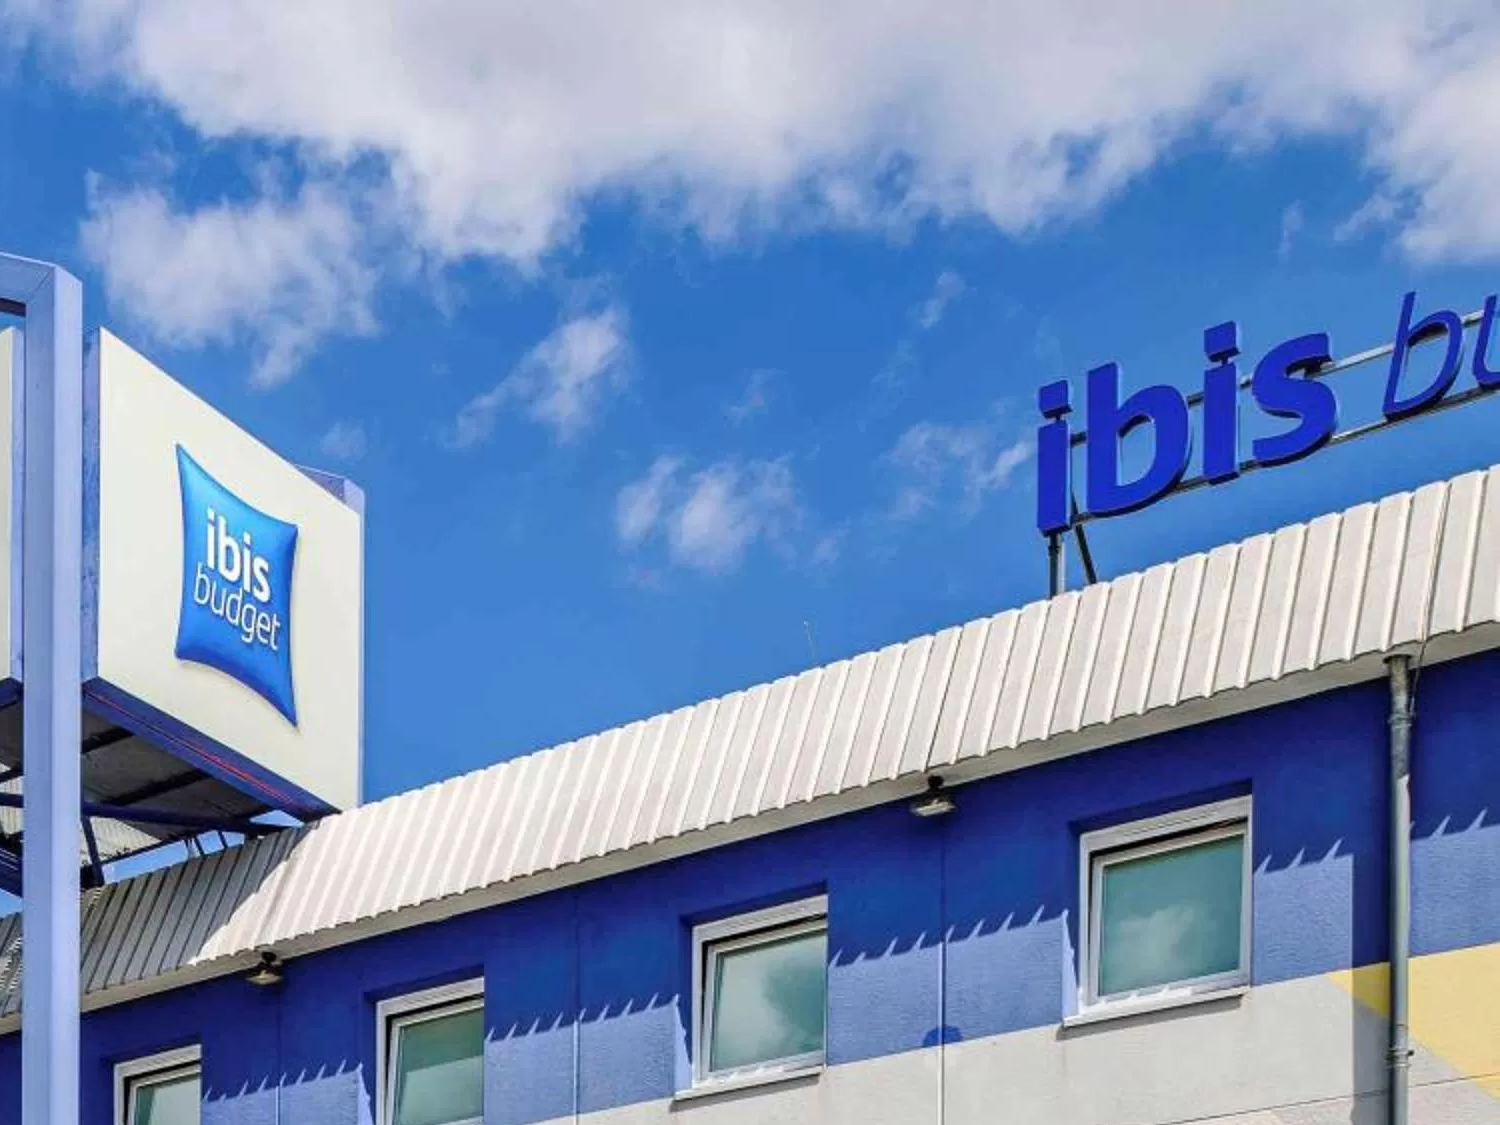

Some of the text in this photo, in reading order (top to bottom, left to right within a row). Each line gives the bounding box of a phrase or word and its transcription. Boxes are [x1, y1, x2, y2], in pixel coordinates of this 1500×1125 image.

[1037, 320, 1338, 536] ibis
[207, 507, 271, 603] ibis
[194, 561, 281, 651] budget
